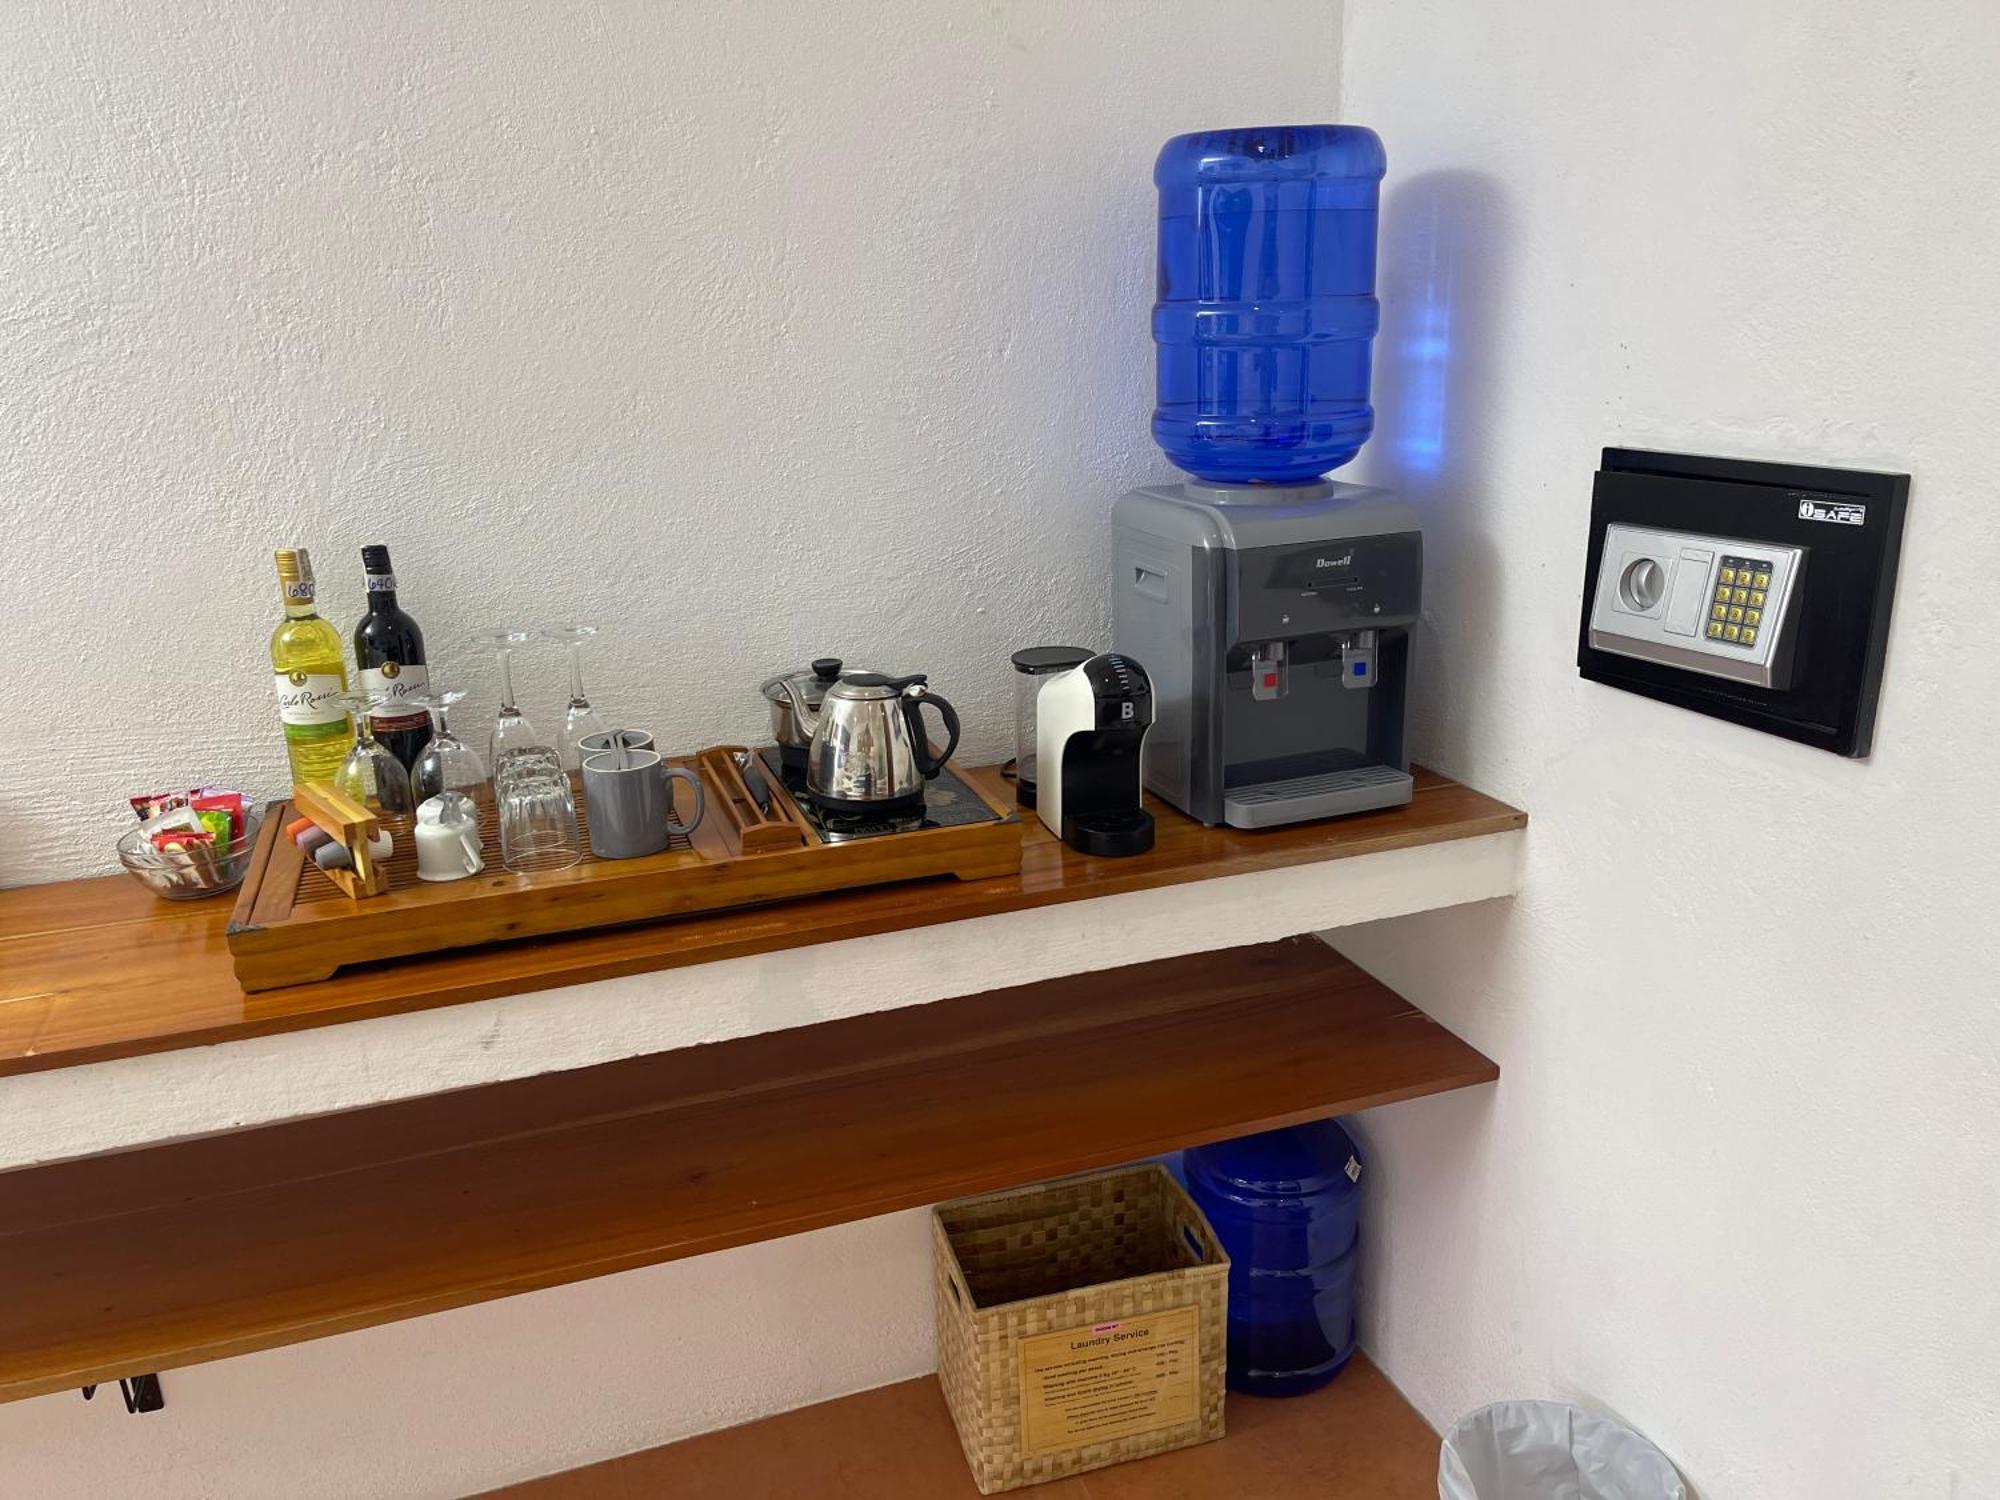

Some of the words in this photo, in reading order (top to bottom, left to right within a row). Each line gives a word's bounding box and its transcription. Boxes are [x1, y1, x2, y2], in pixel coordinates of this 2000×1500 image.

[1316, 556, 1351, 568] Dowell
[300, 687, 338, 710] Rossi
[1121, 702, 1135, 720] B
[1071, 1336, 1110, 1350] Laundry
[1113, 1328, 1150, 1342] Service
